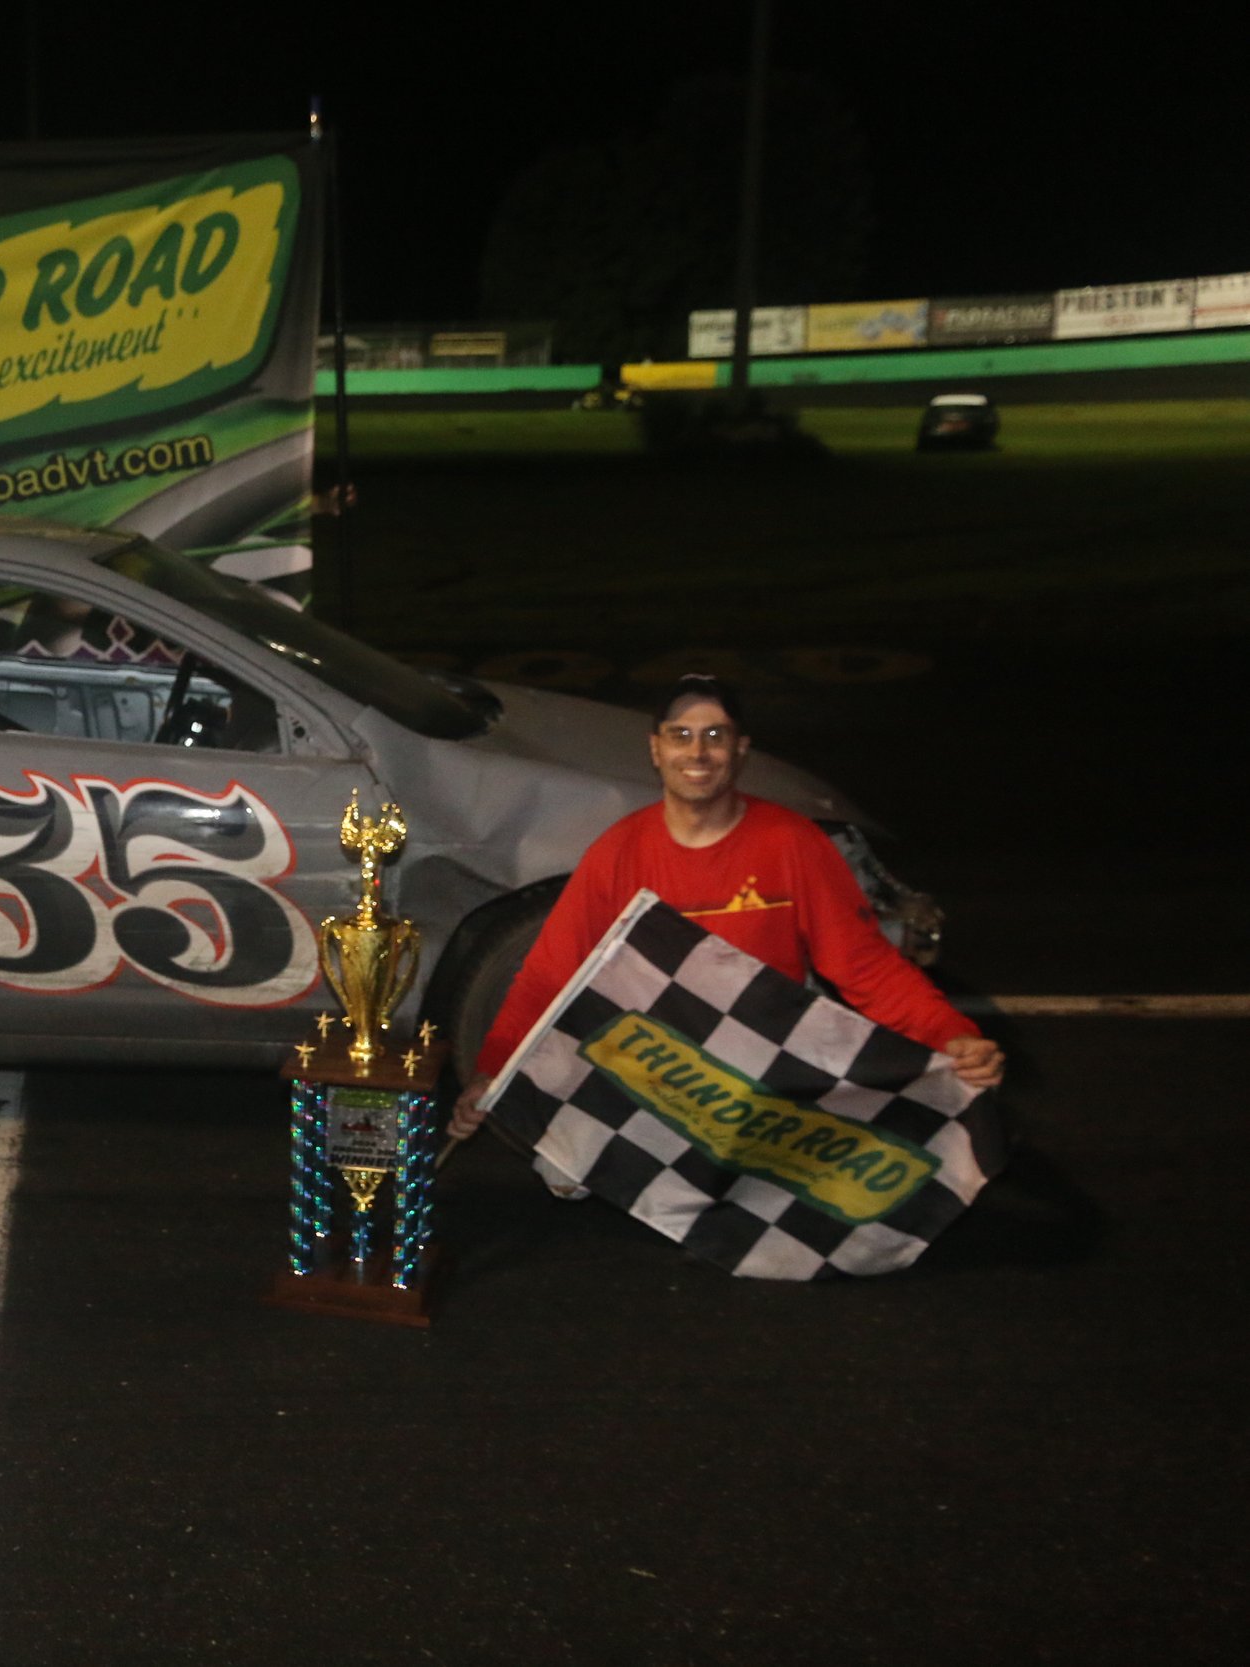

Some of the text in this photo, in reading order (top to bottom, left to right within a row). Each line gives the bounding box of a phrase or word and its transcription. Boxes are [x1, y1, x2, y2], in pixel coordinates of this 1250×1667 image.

[21, 211, 240, 330] ROAD
[619, 1024, 802, 1144] THUNDER
[795, 1128, 908, 1192] ROAD
